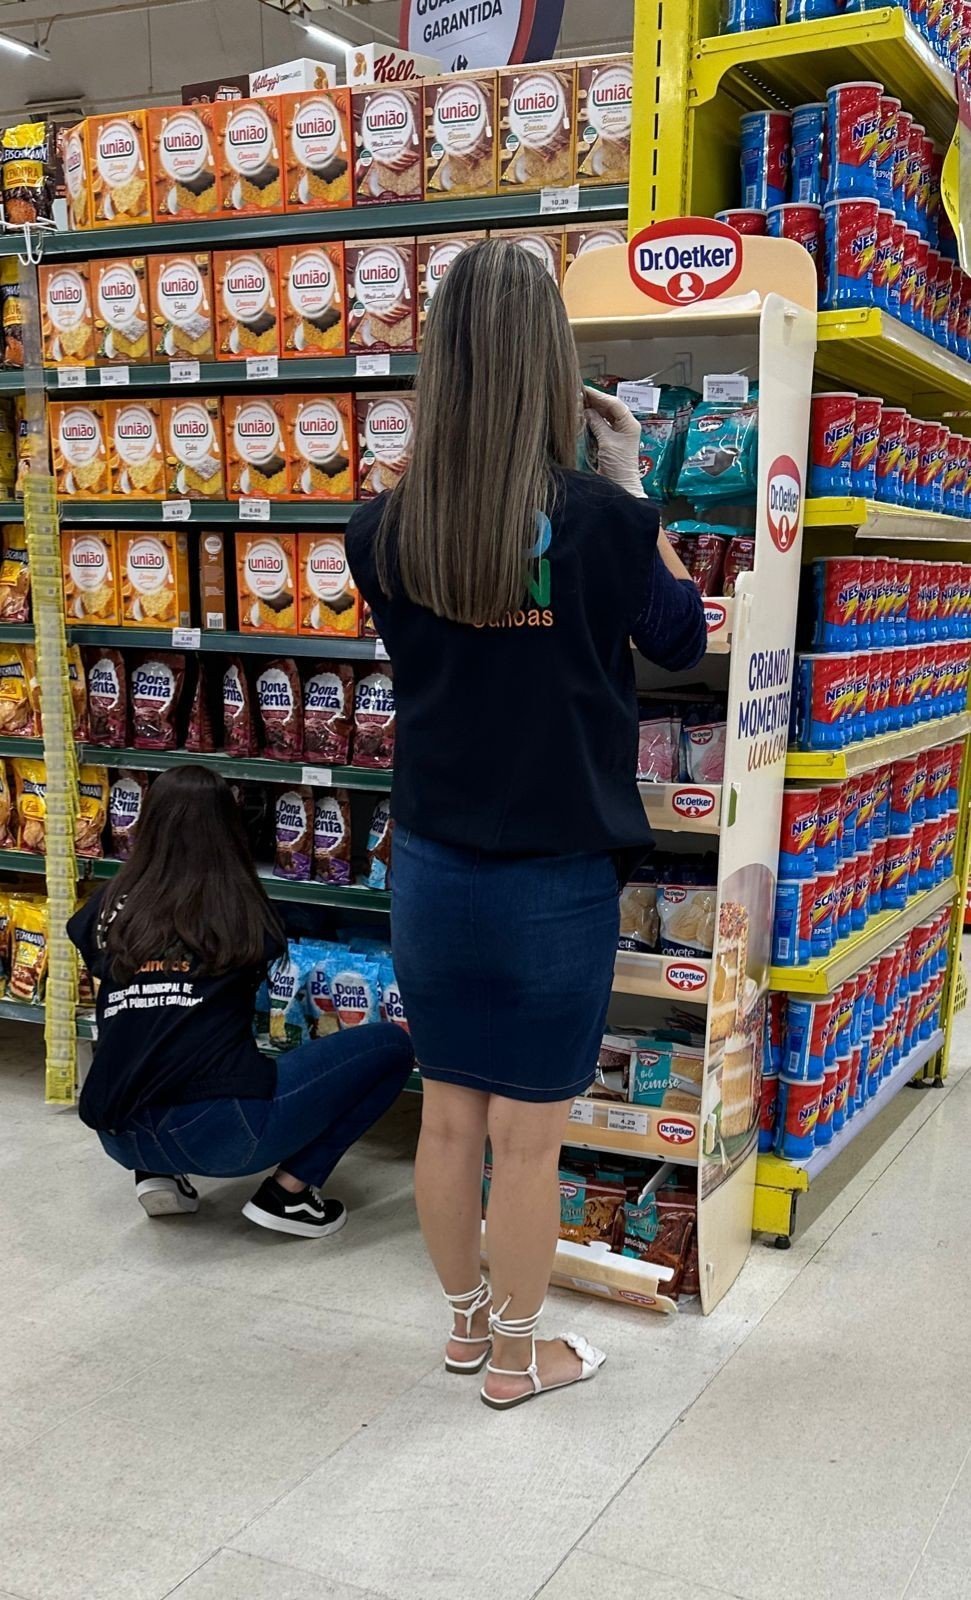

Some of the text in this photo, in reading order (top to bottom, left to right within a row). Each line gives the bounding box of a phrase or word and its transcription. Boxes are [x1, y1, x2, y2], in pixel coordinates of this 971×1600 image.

[423, 0, 502, 42] GARANTIDA
[518, 93, 555, 110] união
[442, 102, 477, 119] união
[370, 110, 404, 127] união
[299, 118, 334, 134] união
[167, 133, 200, 148] união
[232, 125, 265, 143] união
[102, 139, 132, 155] união
[295, 270, 328, 285] união
[362, 265, 397, 280] união
[104, 282, 133, 297] união
[164, 278, 196, 292] união
[230, 275, 262, 290] união
[52, 286, 80, 300] união
[66, 423, 94, 437] união
[121, 422, 150, 436] união
[176, 420, 206, 434] união
[240, 419, 272, 433] união
[302, 417, 335, 432] união
[372, 416, 404, 430] união
[75, 552, 101, 564] união
[133, 552, 162, 566] união
[251, 557, 281, 570] união
[313, 557, 343, 571] união
[93, 669, 113, 682] Dona
[137, 671, 170, 686] Dona
[90, 681, 117, 694] enta
[261, 680, 288, 693] Dona
[309, 682, 338, 696] Dona
[359, 684, 394, 699] Dona
[224, 686, 242, 702] enta
[738, 690, 790, 740] MOMENTOS
[279, 800, 300, 814] Dona
[315, 820, 343, 834] enta
[618, 938, 636, 949] ete
[183, 982, 194, 994] DE
[335, 983, 365, 995] Dona
[160, 996, 165, 1006] E
[334, 994, 368, 1008] Benta
